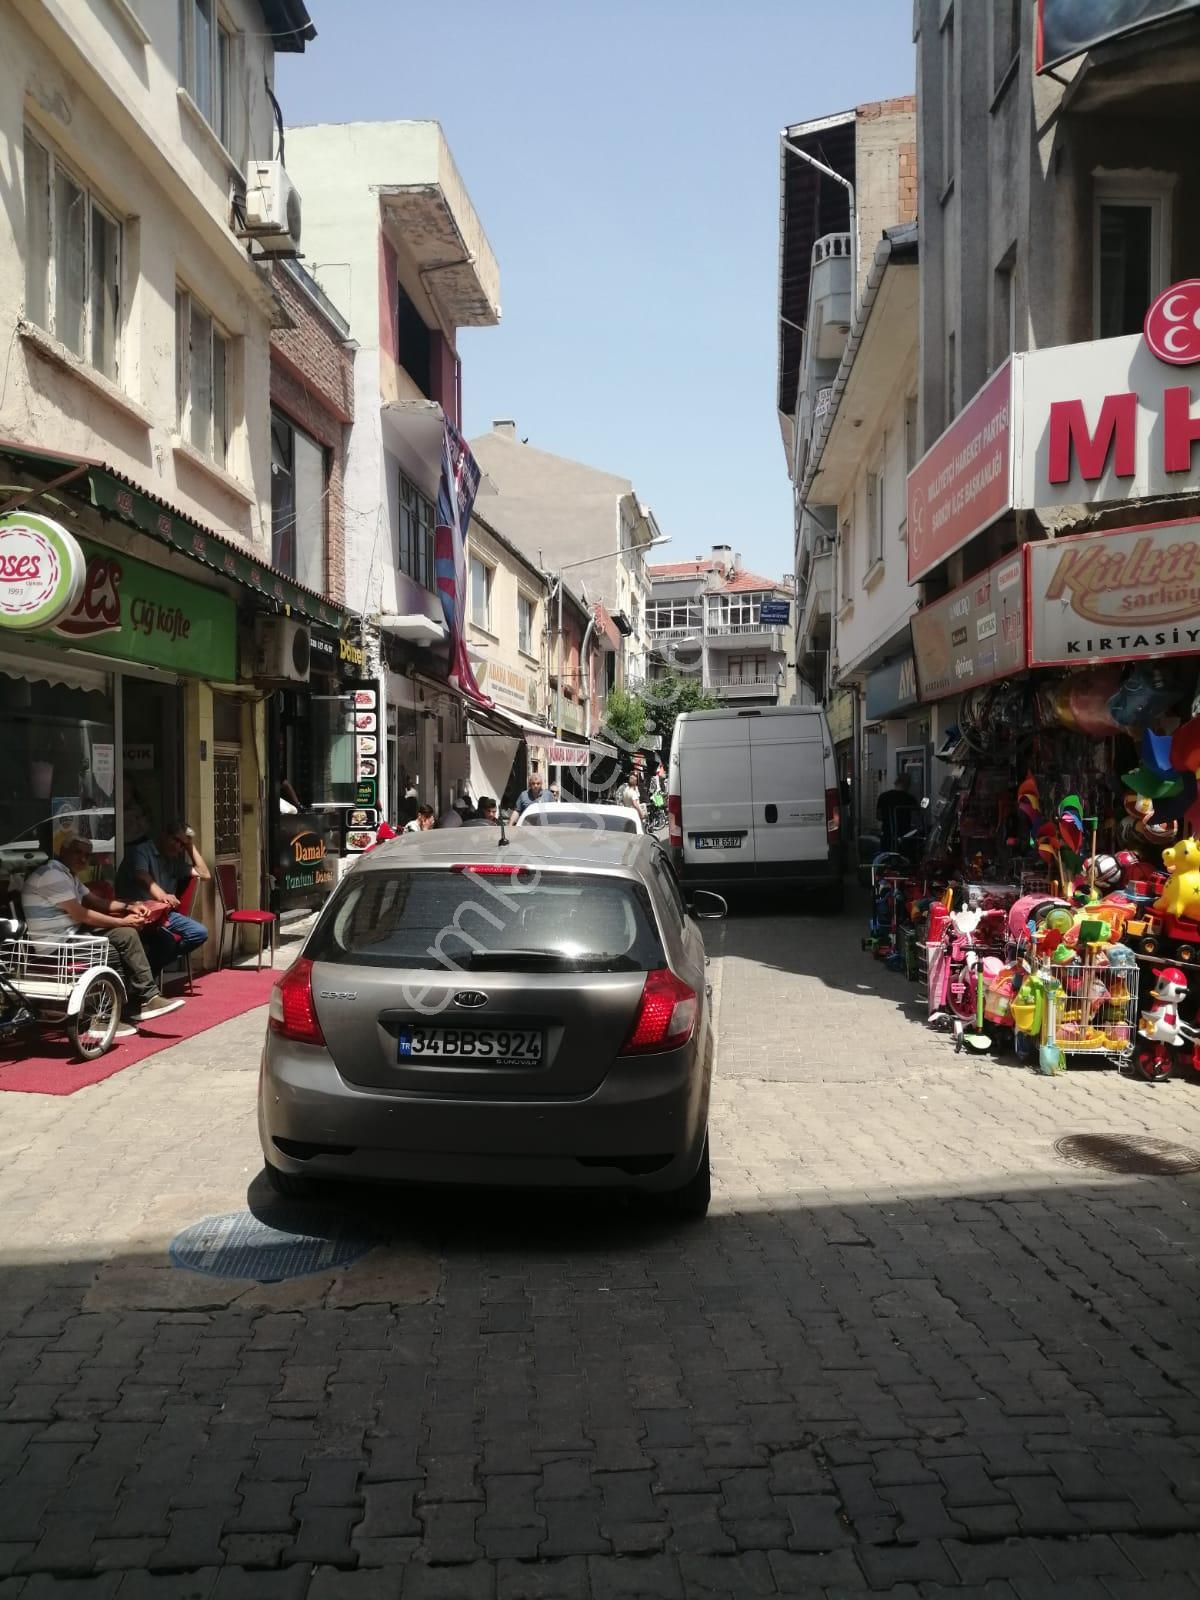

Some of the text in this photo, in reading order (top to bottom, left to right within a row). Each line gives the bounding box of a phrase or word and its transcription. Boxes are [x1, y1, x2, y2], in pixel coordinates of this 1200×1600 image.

[955, 433, 981, 474] HAREKET
[983, 403, 1008, 444] PARTİSİ
[1045, 537, 1200, 600] Kültü
[130, 600, 191, 642] Çiğ köfte
[1067, 628, 1200, 653] KIRTASİY
[295, 839, 327, 862] Damak
[458, 994, 482, 1004] KIA
[401, 1041, 411, 1050] TR
